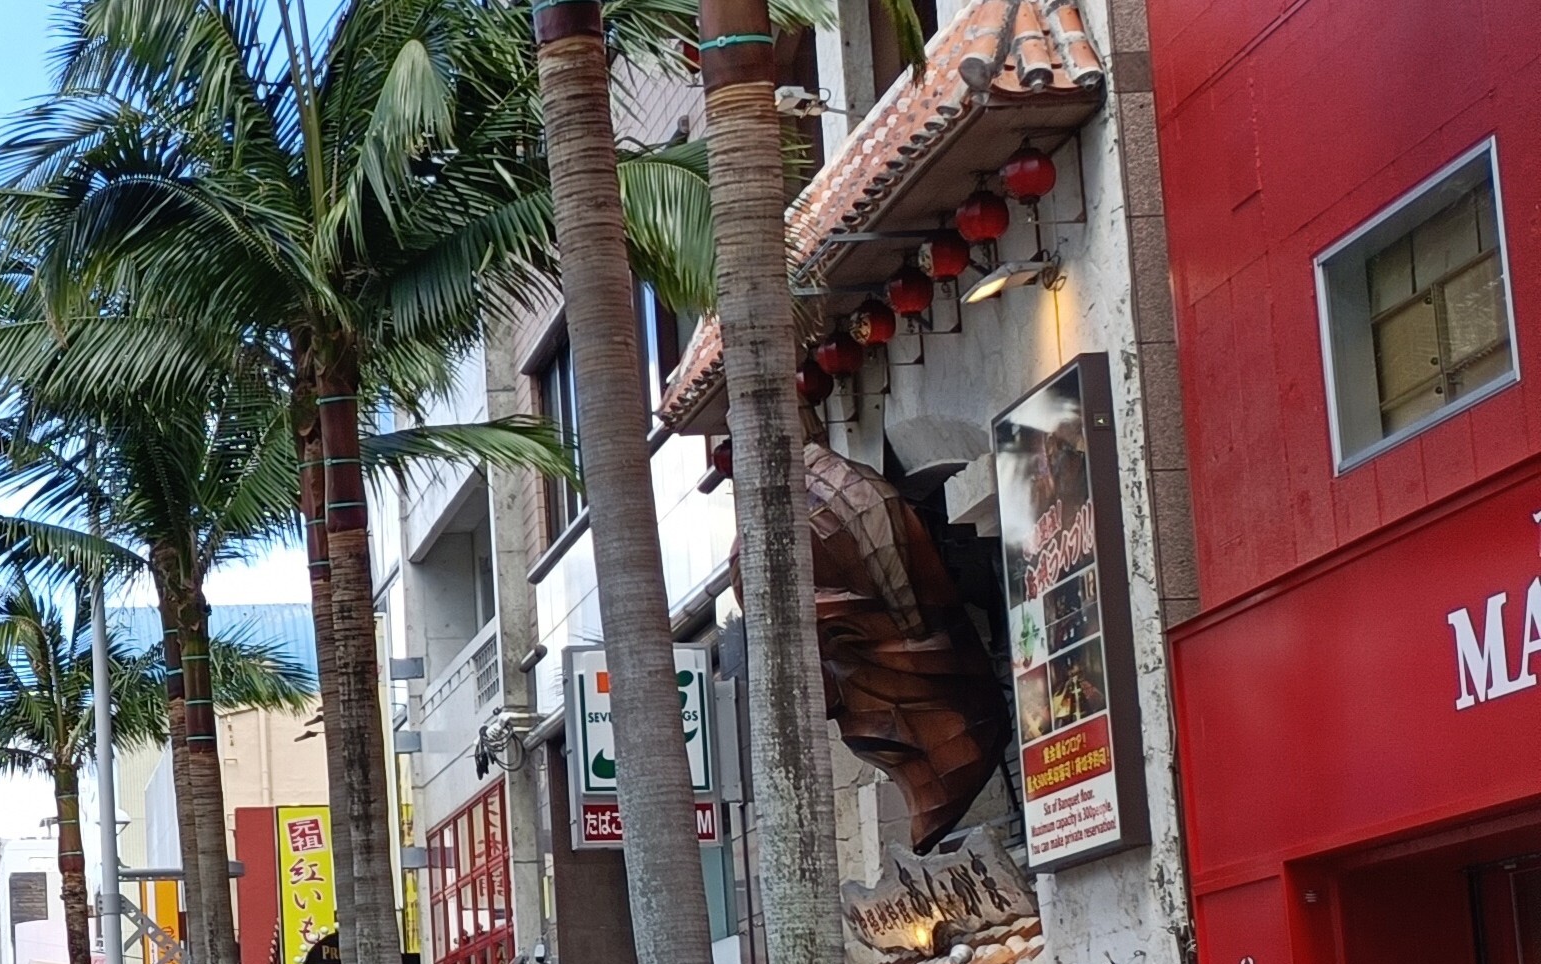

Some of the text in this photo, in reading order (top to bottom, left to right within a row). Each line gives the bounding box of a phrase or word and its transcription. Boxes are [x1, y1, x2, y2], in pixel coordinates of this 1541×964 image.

[1058, 792, 1080, 811] Banquet
[1056, 812, 1077, 833] capacity
[289, 819, 322, 852] 元祖
[1040, 839, 1050, 853] can
[1050, 833, 1064, 850] make
[1064, 829, 1084, 849] private
